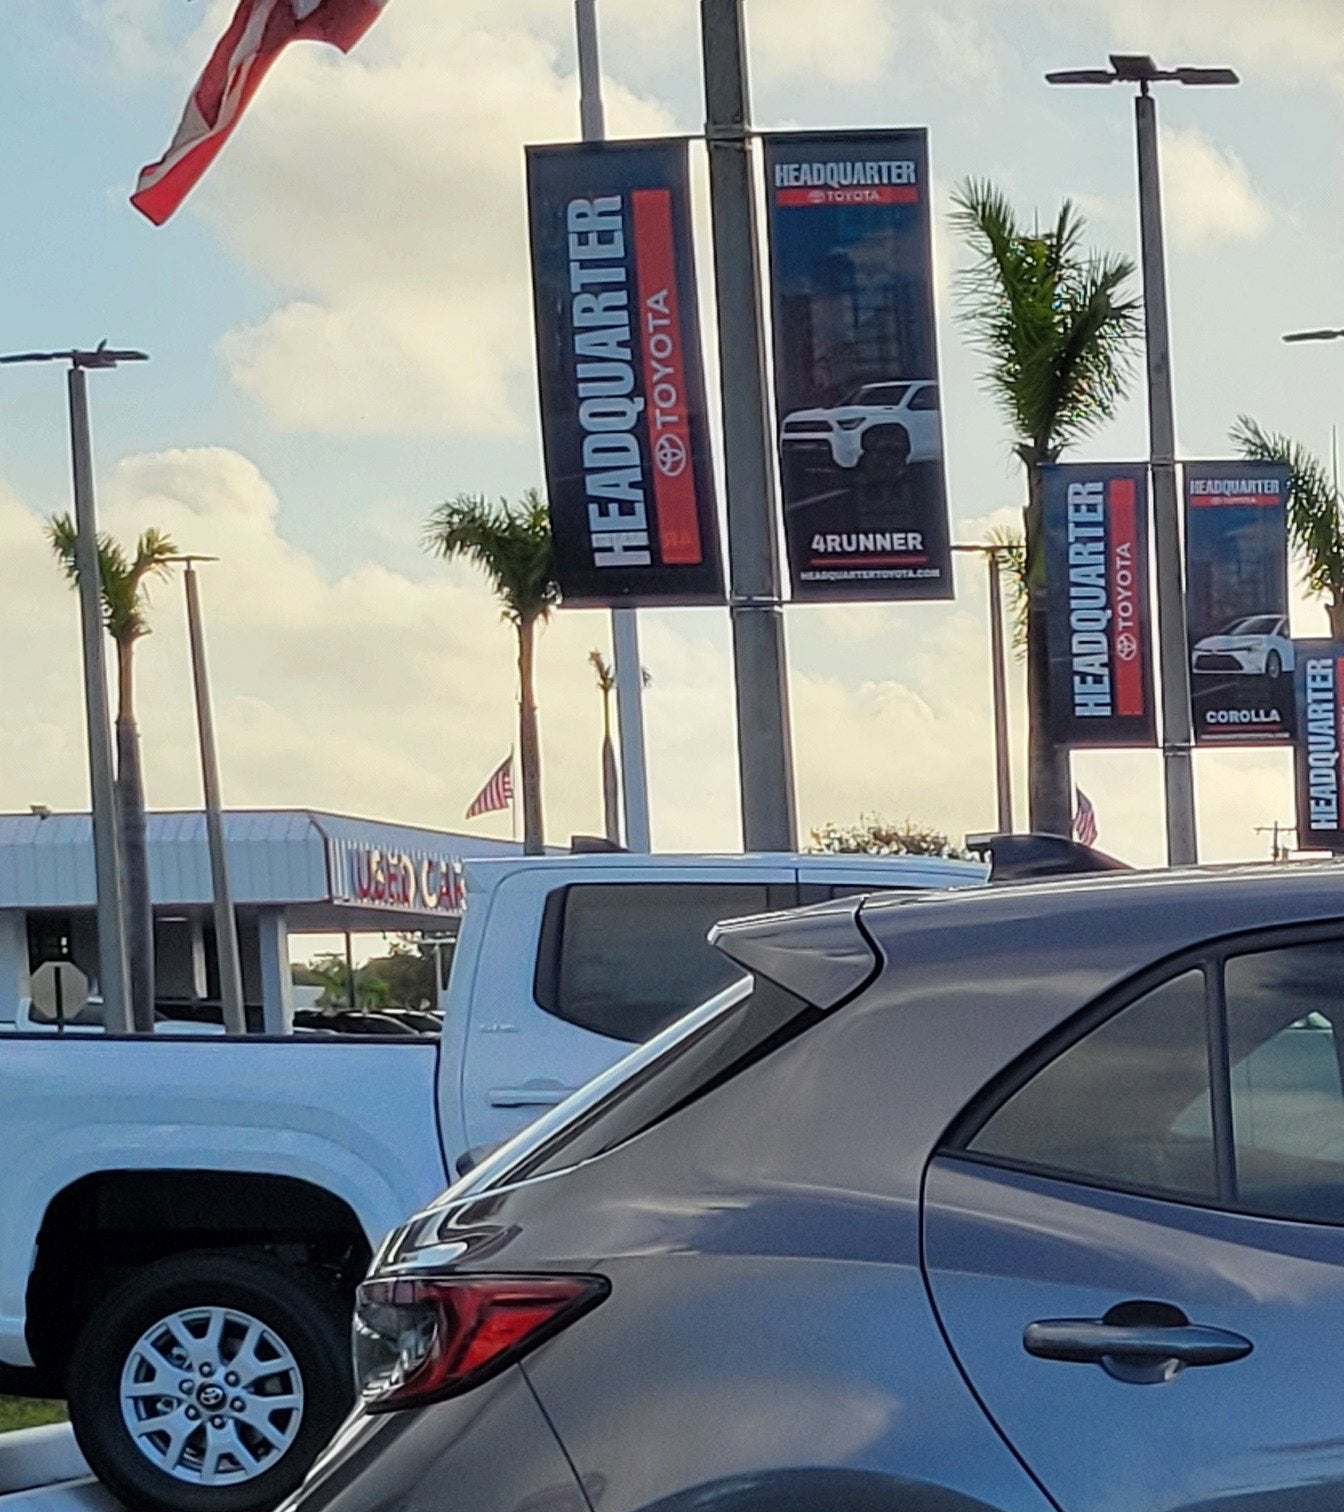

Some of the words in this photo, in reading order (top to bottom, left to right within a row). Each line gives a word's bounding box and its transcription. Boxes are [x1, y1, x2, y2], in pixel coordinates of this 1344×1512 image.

[775, 161, 917, 188] HEADQUARTER
[827, 190, 880, 201] TOYOTA
[567, 195, 651, 567] HEADQUARTER
[647, 289, 678, 429] TOYOTA
[1190, 480, 1279, 496] HEADQUARTER
[811, 532, 924, 552] 4RUNNER
[1067, 482, 1112, 716] HEADQUARTER
[1116, 542, 1134, 631] TOYOTA
[1206, 709, 1281, 723] COROLLA
[1306, 658, 1340, 830] HEADQUARTER
[357, 850, 417, 905] USED
